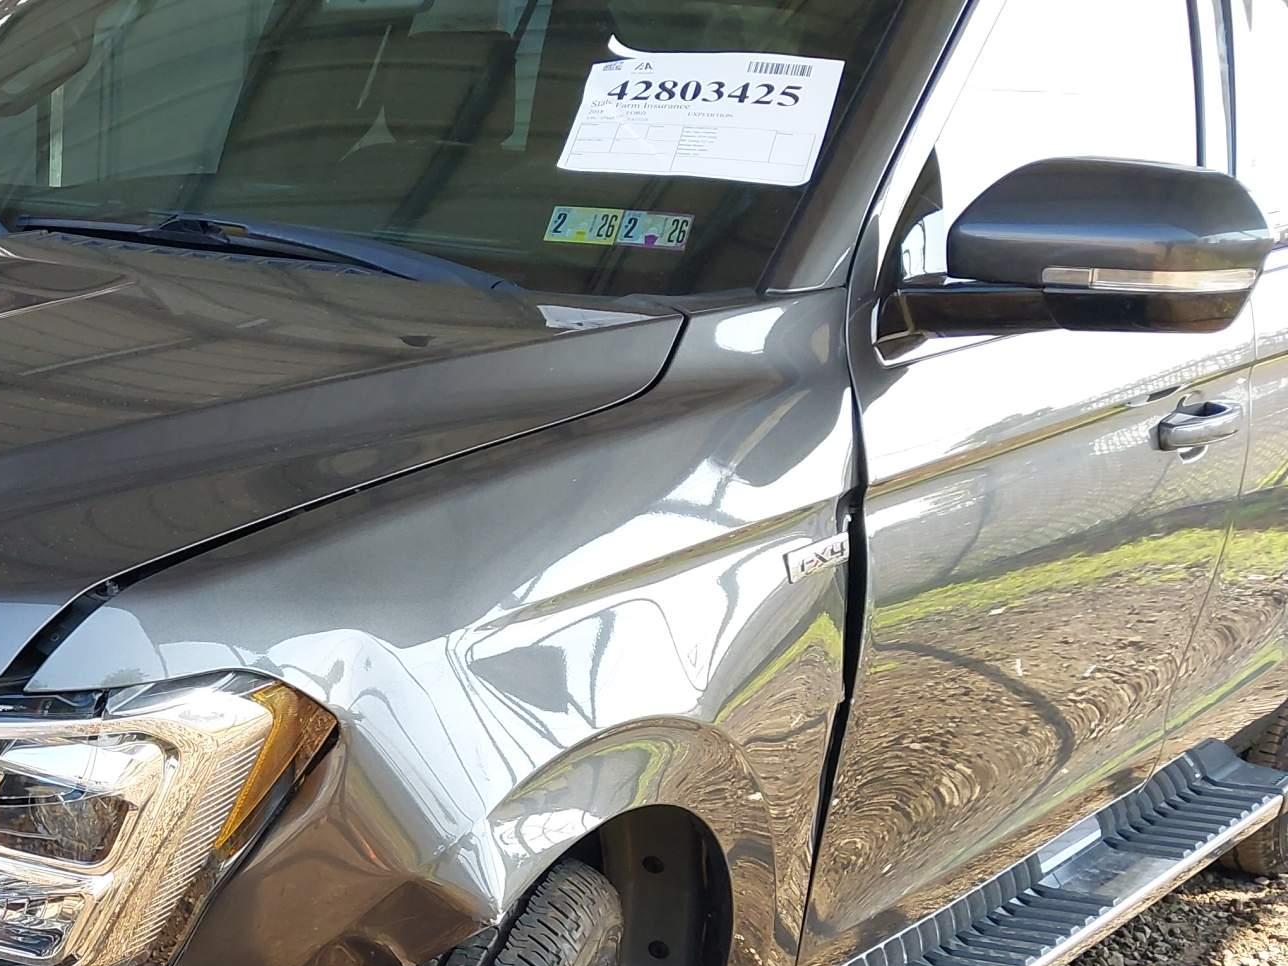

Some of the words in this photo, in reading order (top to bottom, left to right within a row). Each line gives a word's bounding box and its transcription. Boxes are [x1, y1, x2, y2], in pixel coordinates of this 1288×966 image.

[607, 79, 802, 107] 42803425
[615, 101, 640, 109] Farm
[643, 101, 690, 110] Insurance
[552, 212, 568, 234] 2
[596, 213, 619, 238] 26
[623, 217, 638, 239] 2
[667, 218, 689, 244] 26
